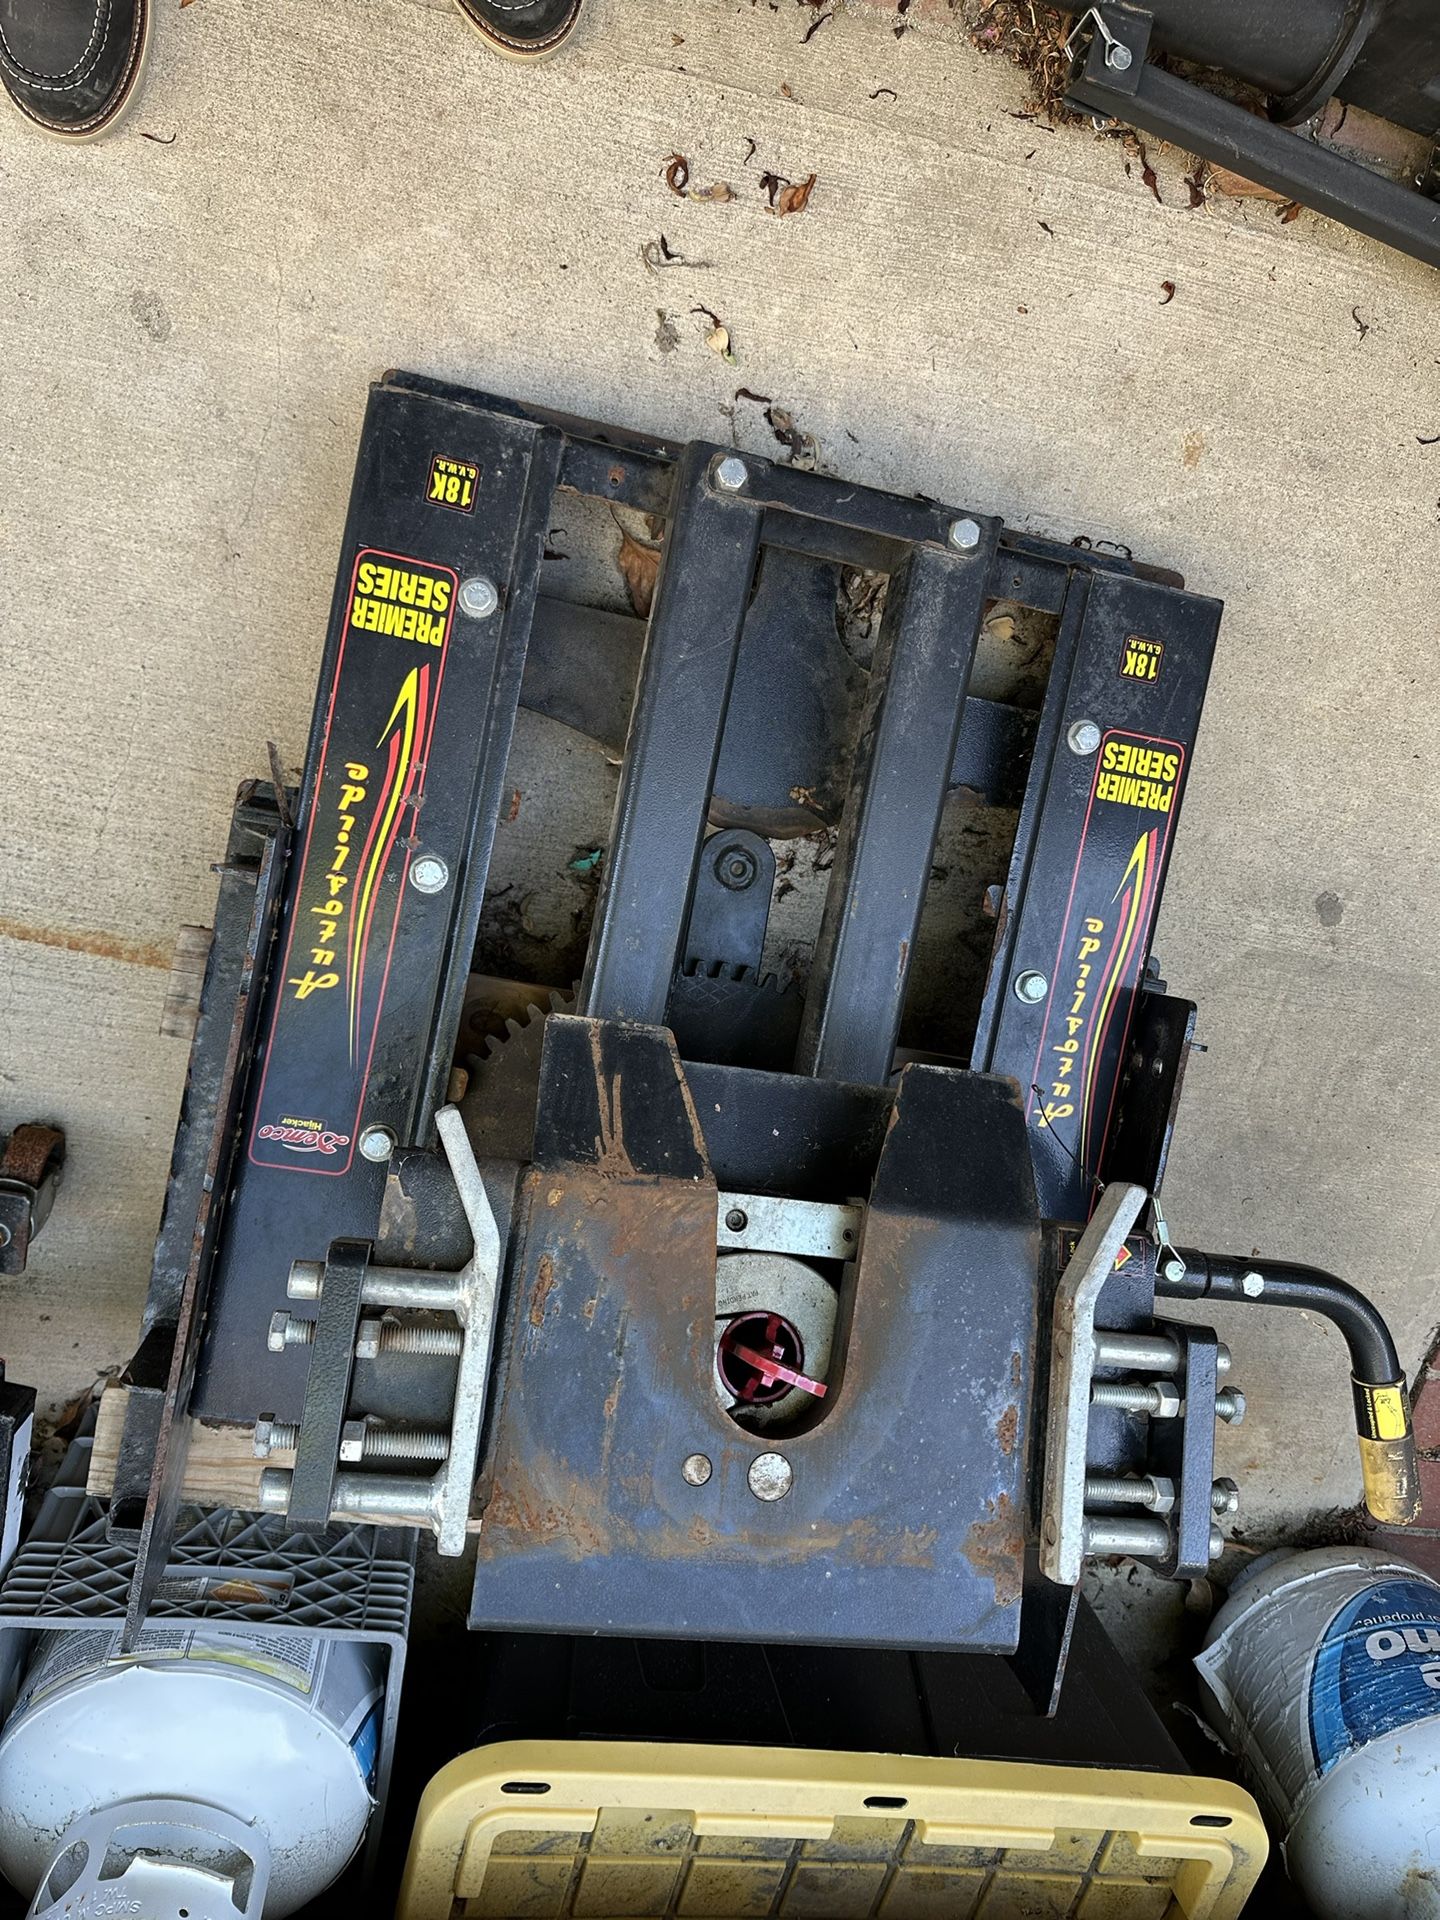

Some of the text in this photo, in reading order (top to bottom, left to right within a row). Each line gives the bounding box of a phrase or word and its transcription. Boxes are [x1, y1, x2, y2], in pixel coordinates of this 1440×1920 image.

[436, 459, 476, 479] G.V.W.R.
[429, 472, 471, 507] 18K
[357, 563, 451, 612] SERIES
[351, 596, 446, 647] PREMIER
[1128, 639, 1161, 654] G.V.W.R.
[1123, 651, 1157, 680] 18K
[1102, 741, 1179, 782] SERIES
[1096, 772, 1173, 813] PREMIER
[287, 761, 369, 999] Autoslide
[258, 1125, 349, 1154] Demco
[281, 1117, 323, 1131] Hijacker
[717, 1294, 747, 1307] PENDING
